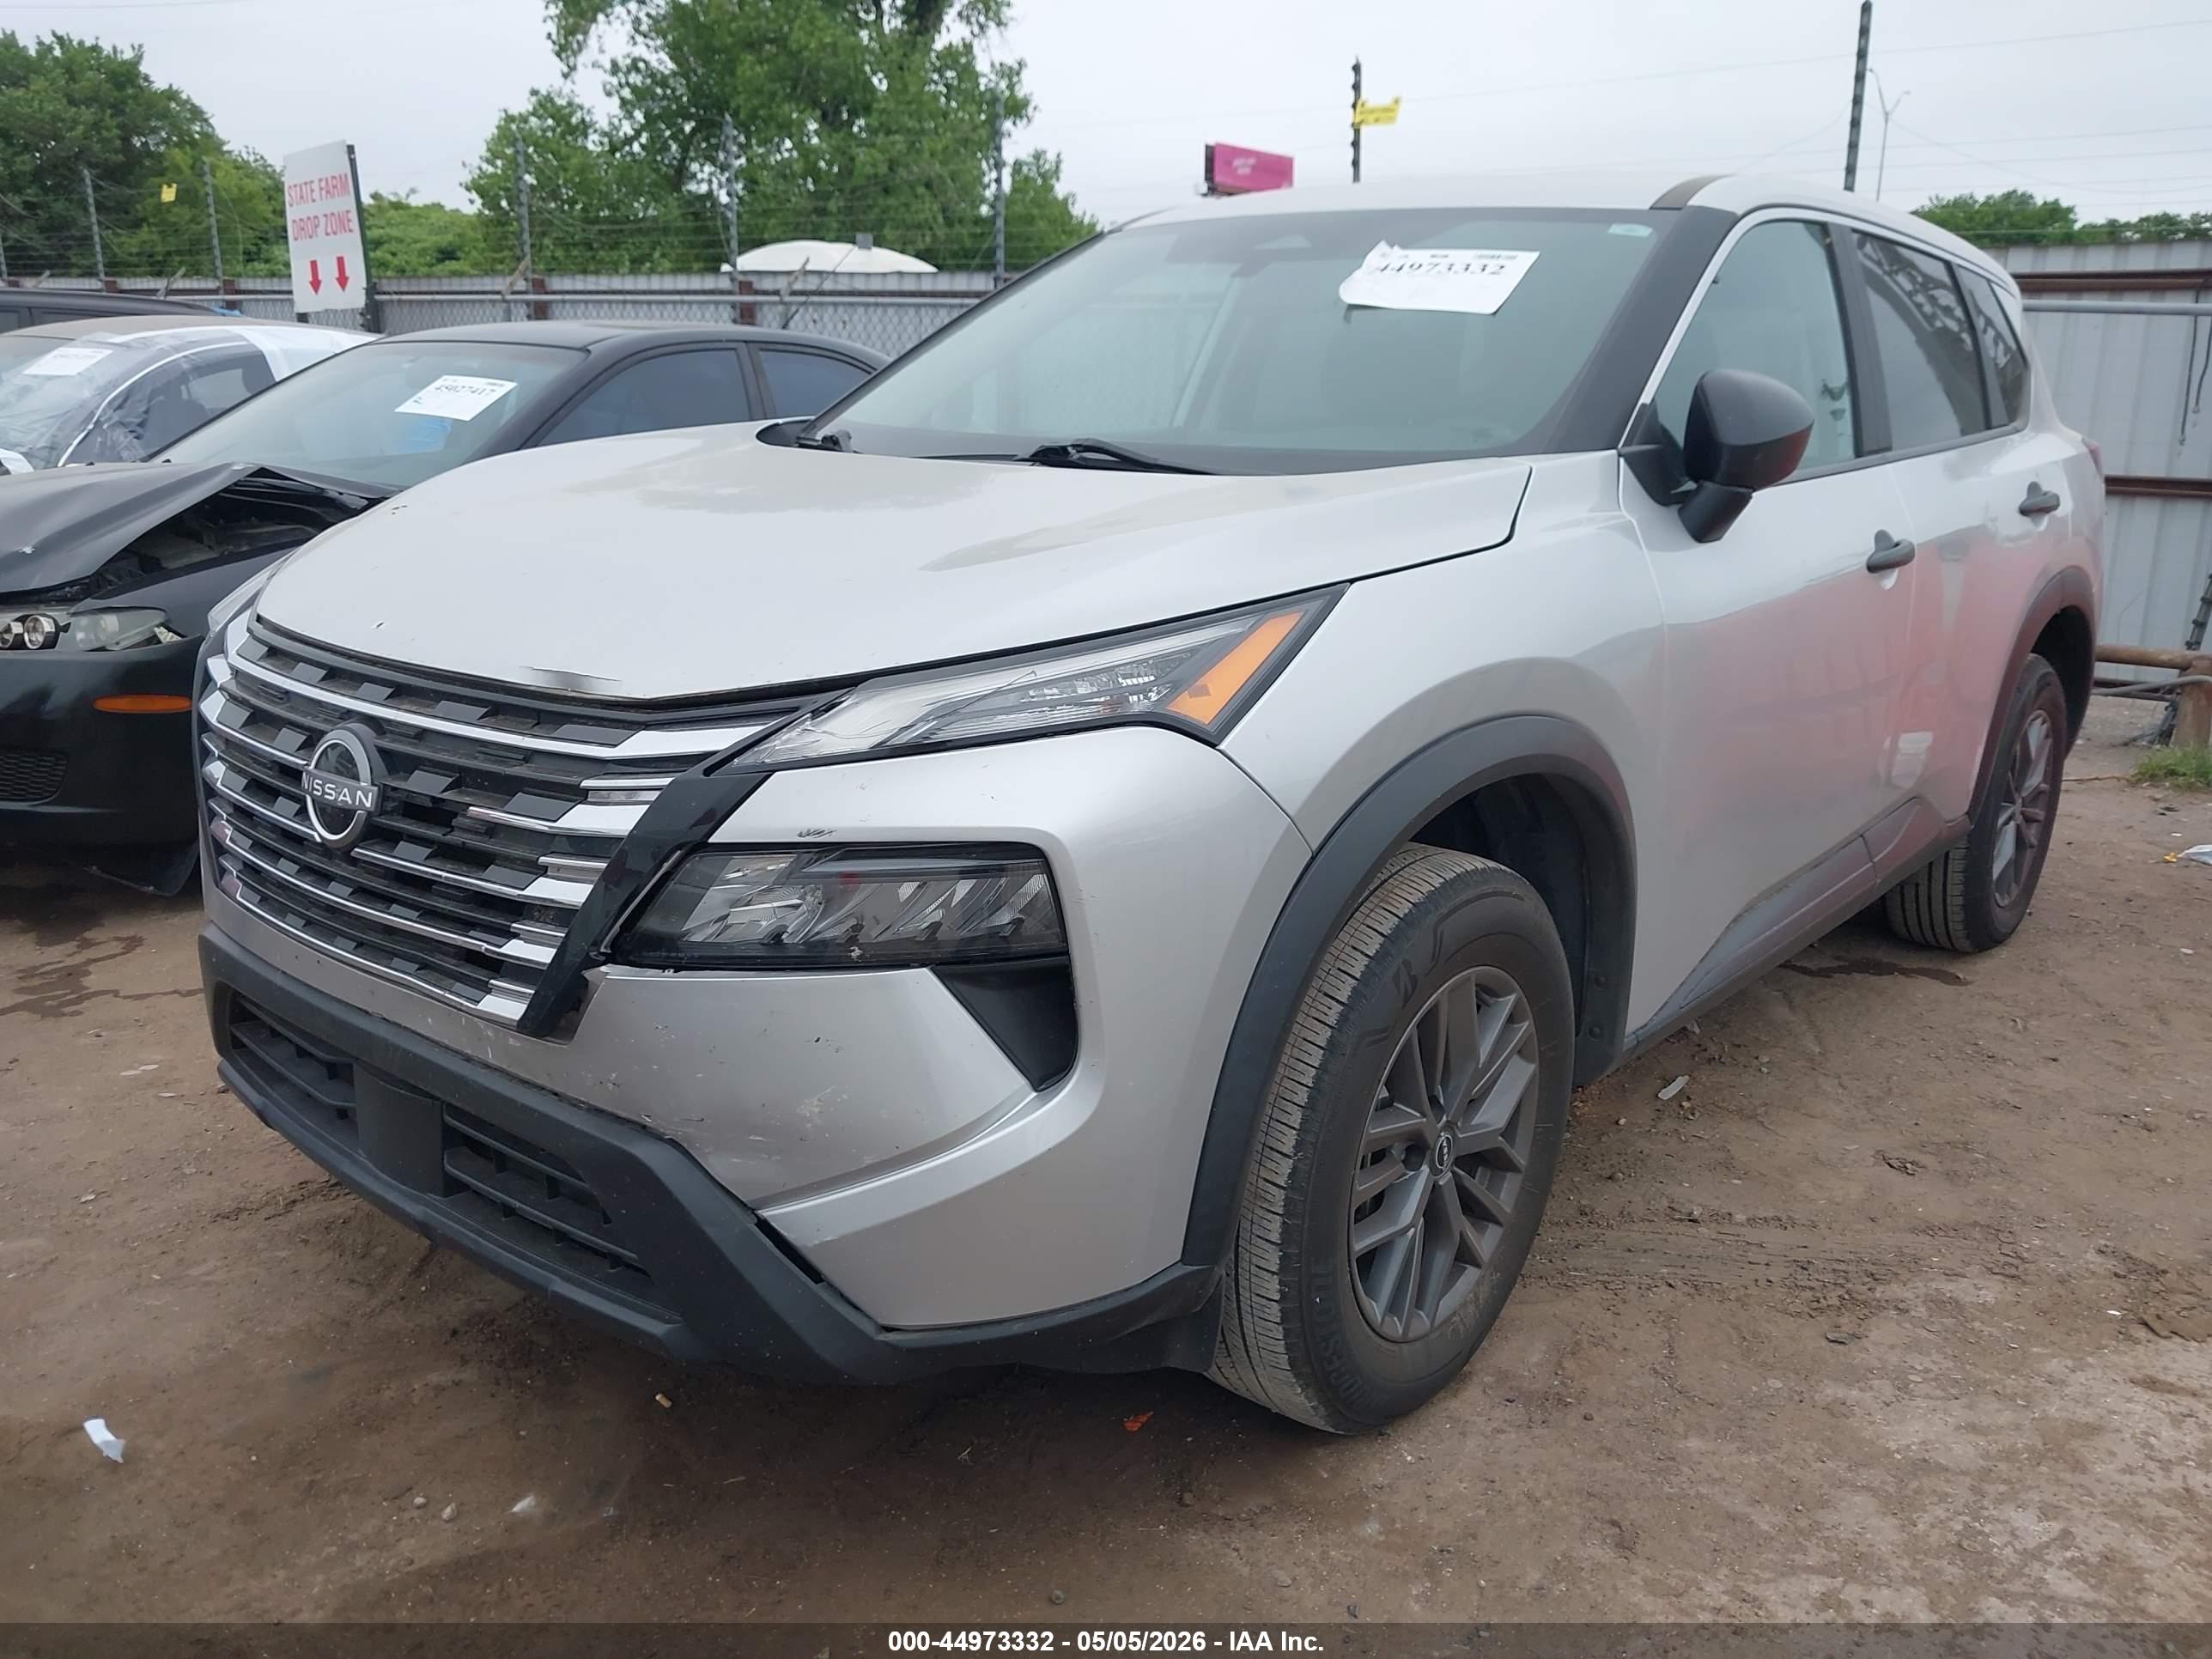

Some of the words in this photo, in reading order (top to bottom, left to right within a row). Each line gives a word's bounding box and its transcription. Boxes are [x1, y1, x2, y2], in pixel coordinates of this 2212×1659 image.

[288, 179, 317, 208] STATE
[318, 173, 350, 201] FARM
[291, 215, 320, 241] DROP
[323, 210, 354, 237] ZONE
[301, 770, 373, 808] NISSAN
